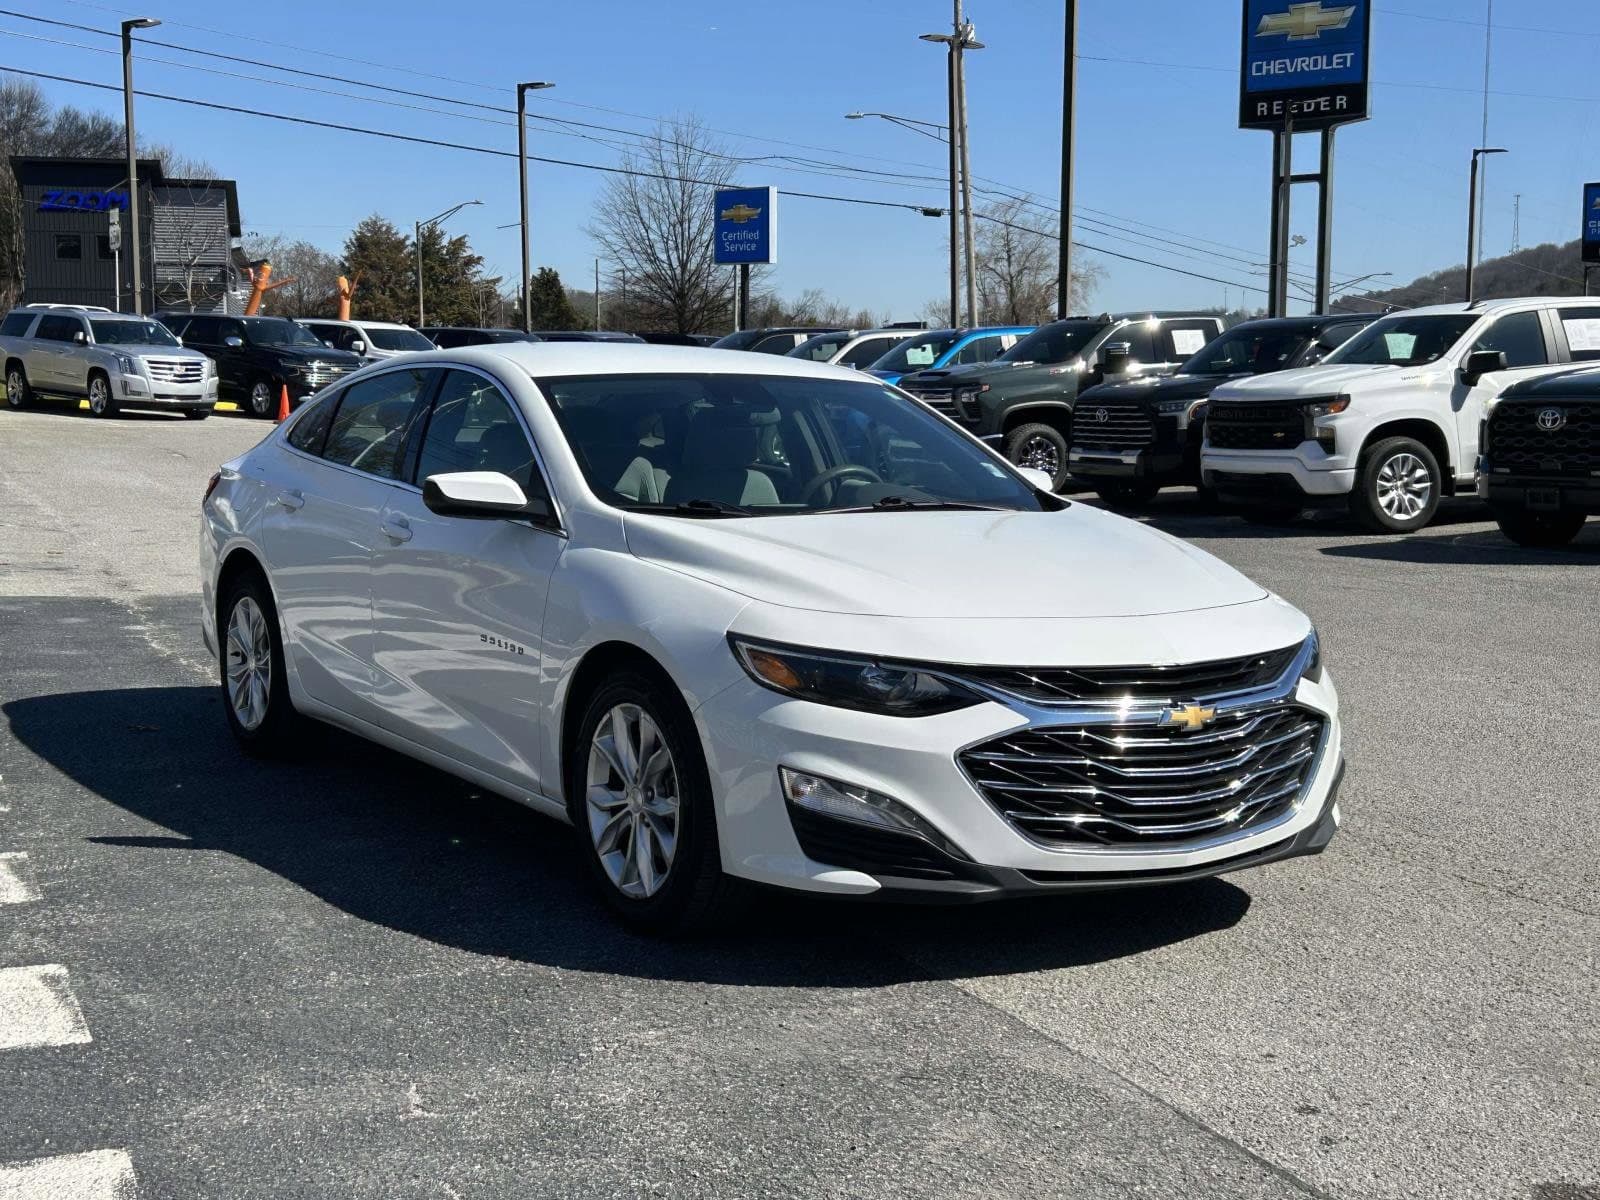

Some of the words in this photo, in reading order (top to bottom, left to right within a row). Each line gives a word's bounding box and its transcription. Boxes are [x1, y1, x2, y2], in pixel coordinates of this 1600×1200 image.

[1251, 52, 1355, 76] CHEVROLET
[40, 189, 129, 211] ZOOM
[722, 230, 759, 241] Certified
[724, 241, 757, 252] Service
